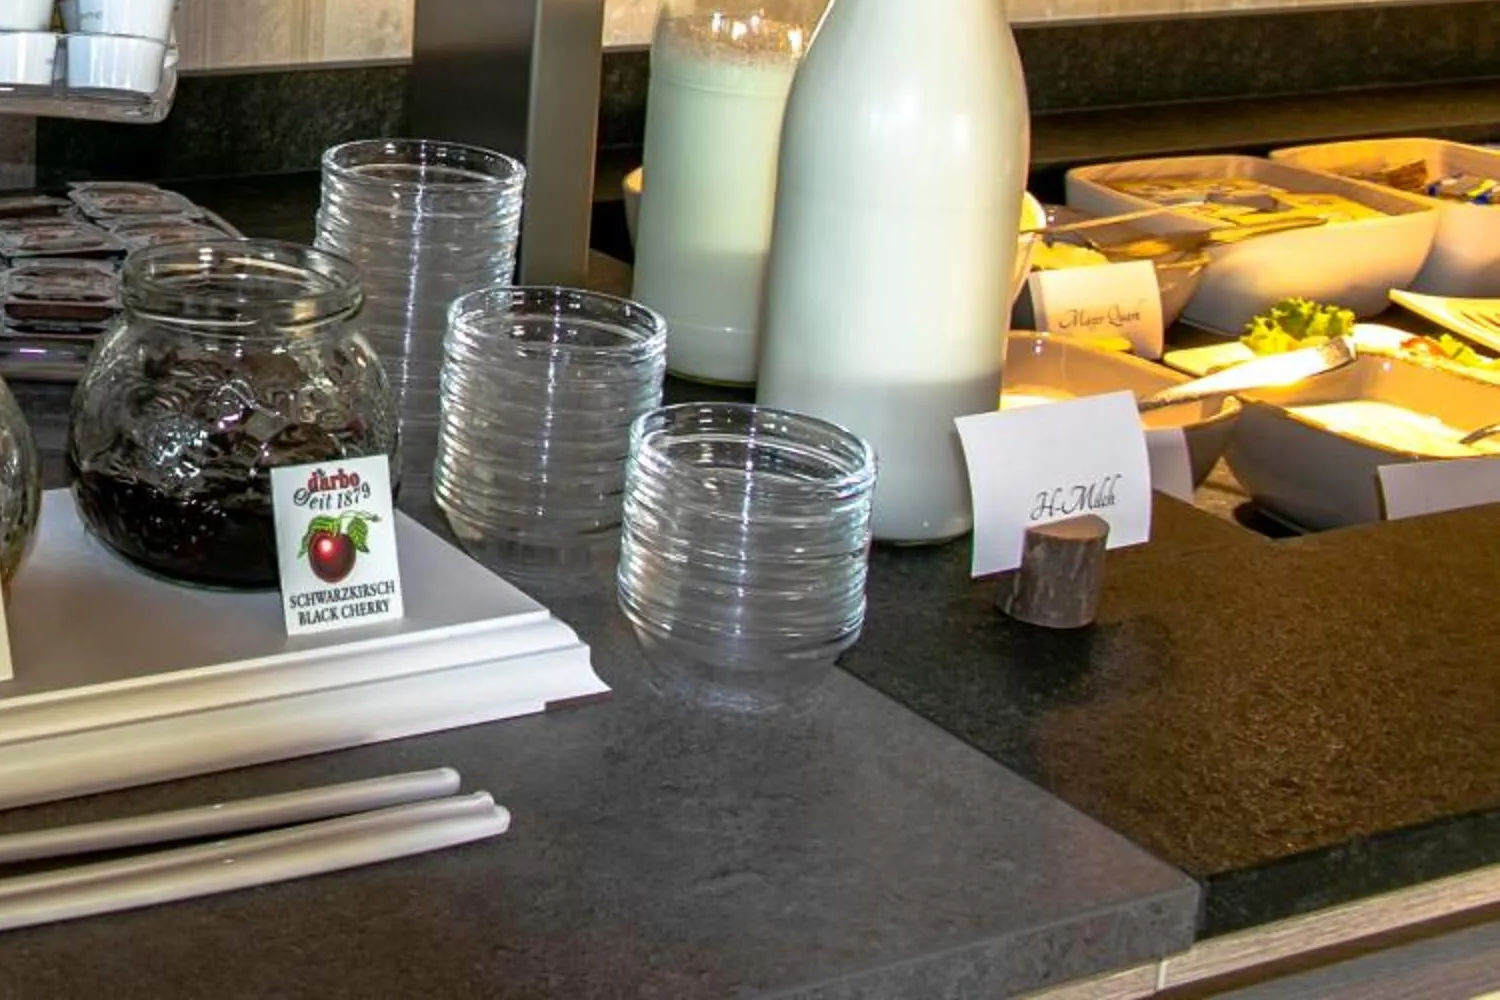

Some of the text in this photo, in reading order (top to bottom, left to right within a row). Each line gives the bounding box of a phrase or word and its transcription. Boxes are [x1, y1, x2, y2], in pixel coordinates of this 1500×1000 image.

[337, 482, 372, 510] 1879
[289, 580, 396, 609] SCHWARZKIRSCH
[298, 599, 391, 627] BLACK CHERRY
